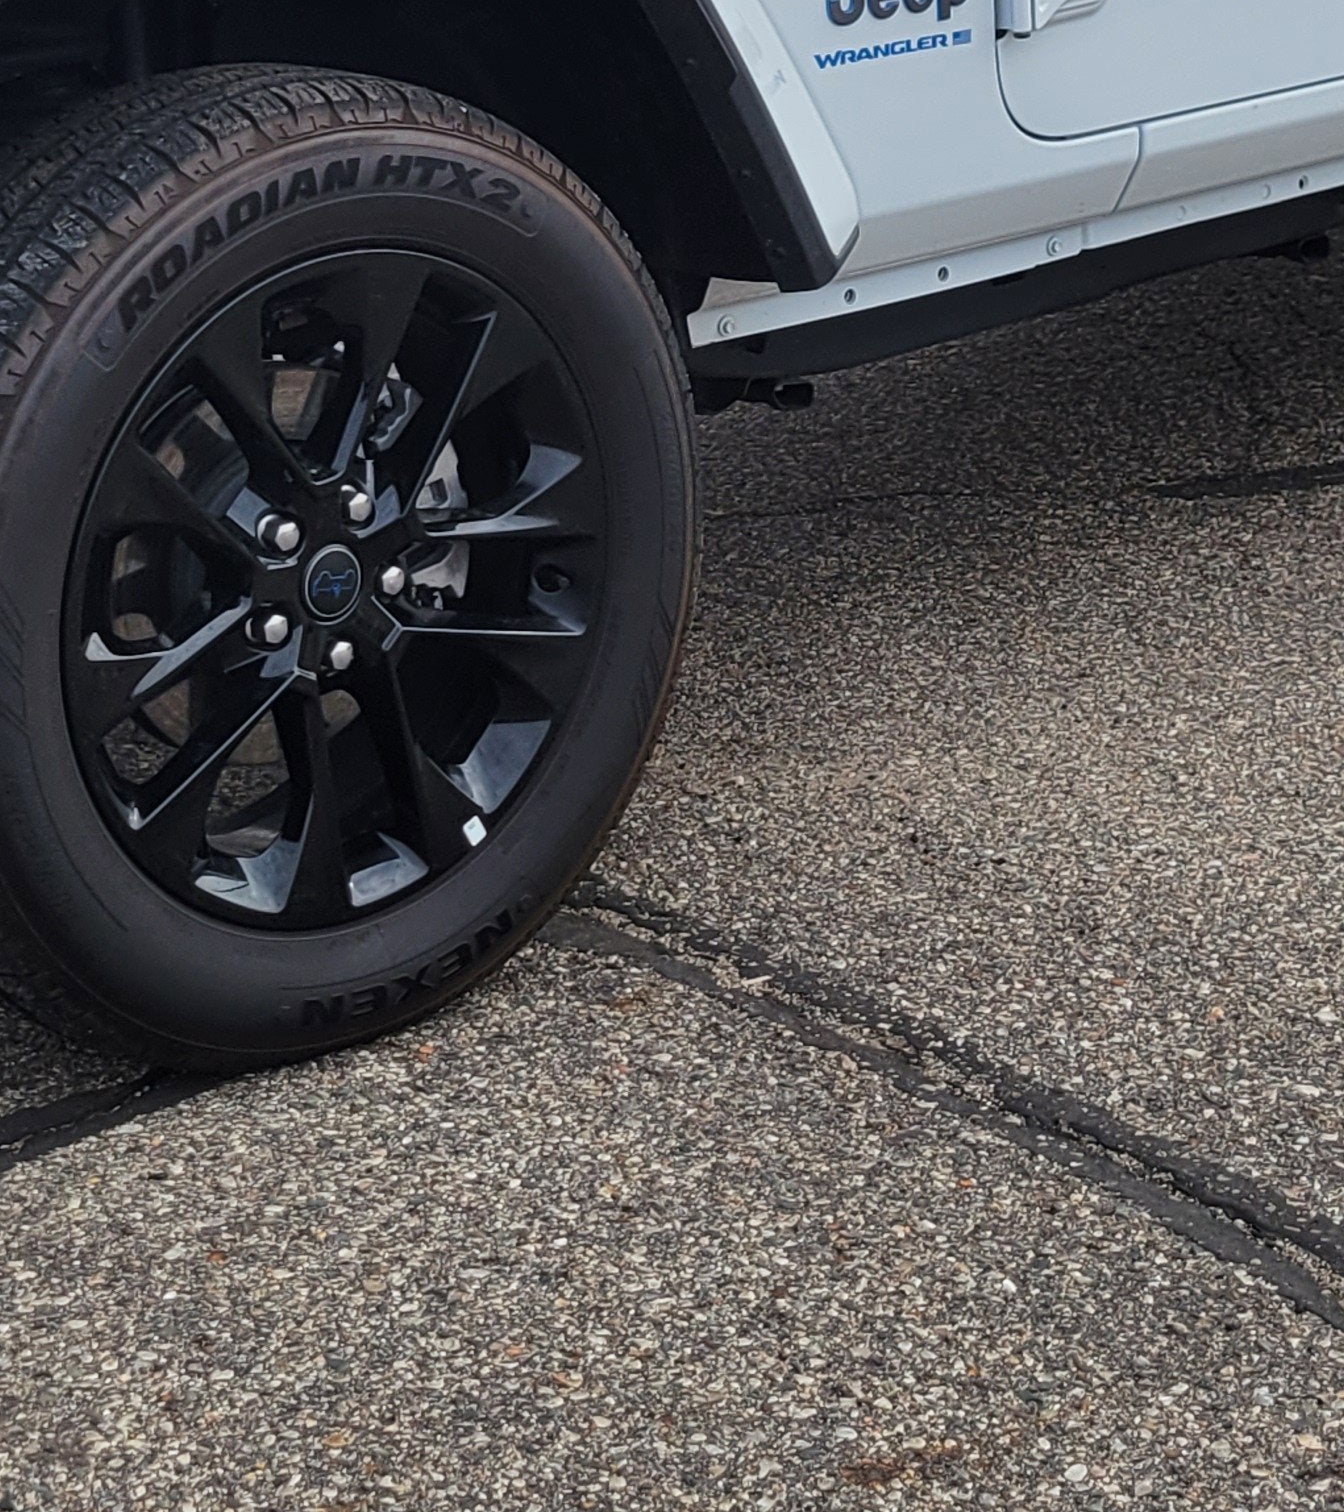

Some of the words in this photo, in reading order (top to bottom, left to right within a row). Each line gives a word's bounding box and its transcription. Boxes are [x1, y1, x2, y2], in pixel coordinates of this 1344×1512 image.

[813, 33, 949, 70] WRANGLER
[114, 156, 361, 334] ROADIAN
[372, 153, 524, 212] HTX2
[302, 907, 513, 1024] NEXEN
